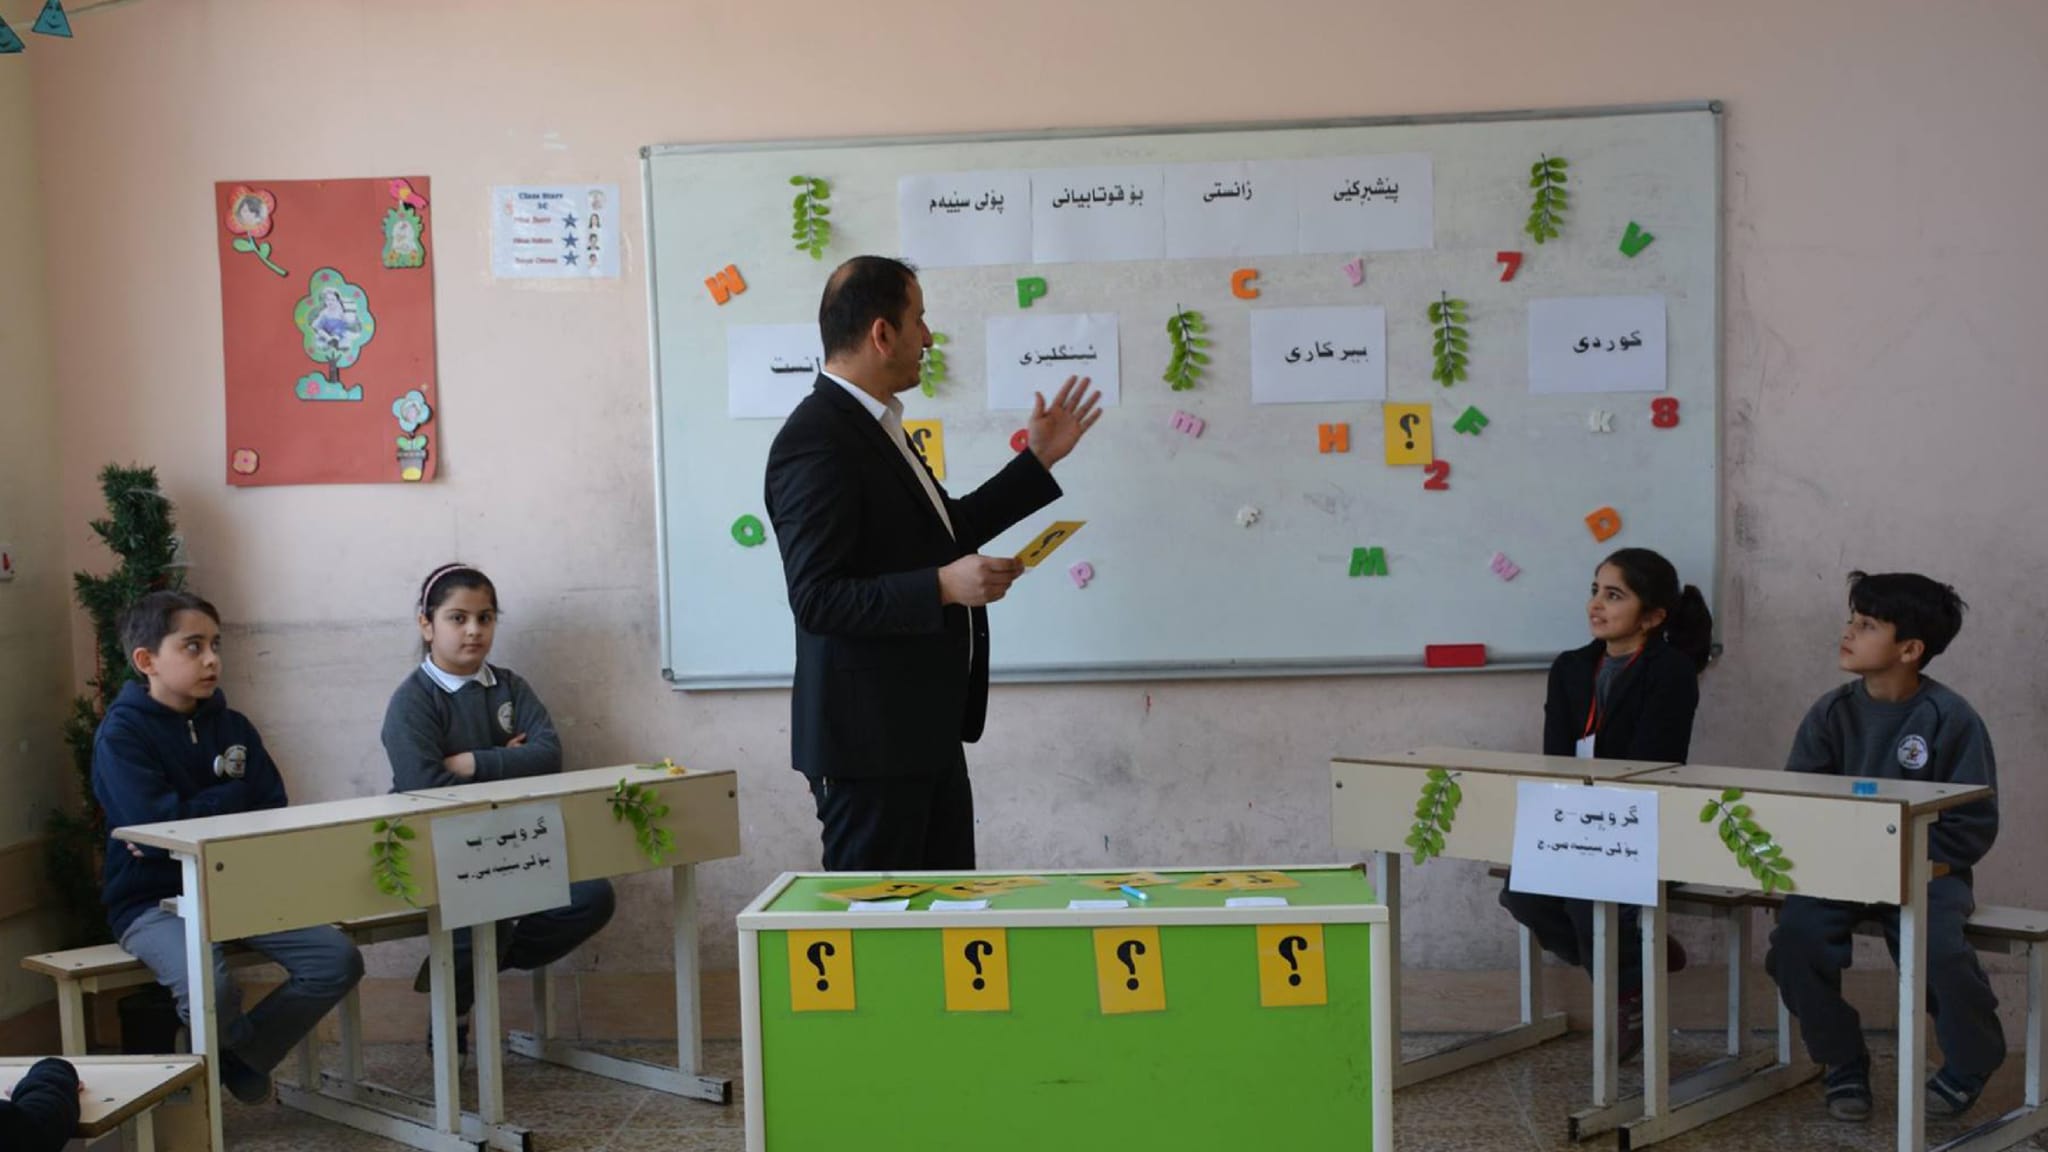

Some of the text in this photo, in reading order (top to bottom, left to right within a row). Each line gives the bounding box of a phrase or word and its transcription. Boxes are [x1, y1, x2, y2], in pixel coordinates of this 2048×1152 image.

[1051, 184, 1125, 208] قوتابیانی
[1202, 180, 1253, 202] زانستی
[1496, 251, 1523, 283] 7
[1016, 276, 1047, 309] P
[1230, 268, 1261, 300] C
[1284, 341, 1369, 363] بیرکاری
[1572, 330, 1643, 354] کوردی
[771, 356, 820, 374] انست
[1651, 397, 1680, 429] 8
[1317, 422, 1350, 454] H
[1424, 459, 1451, 491] 2
